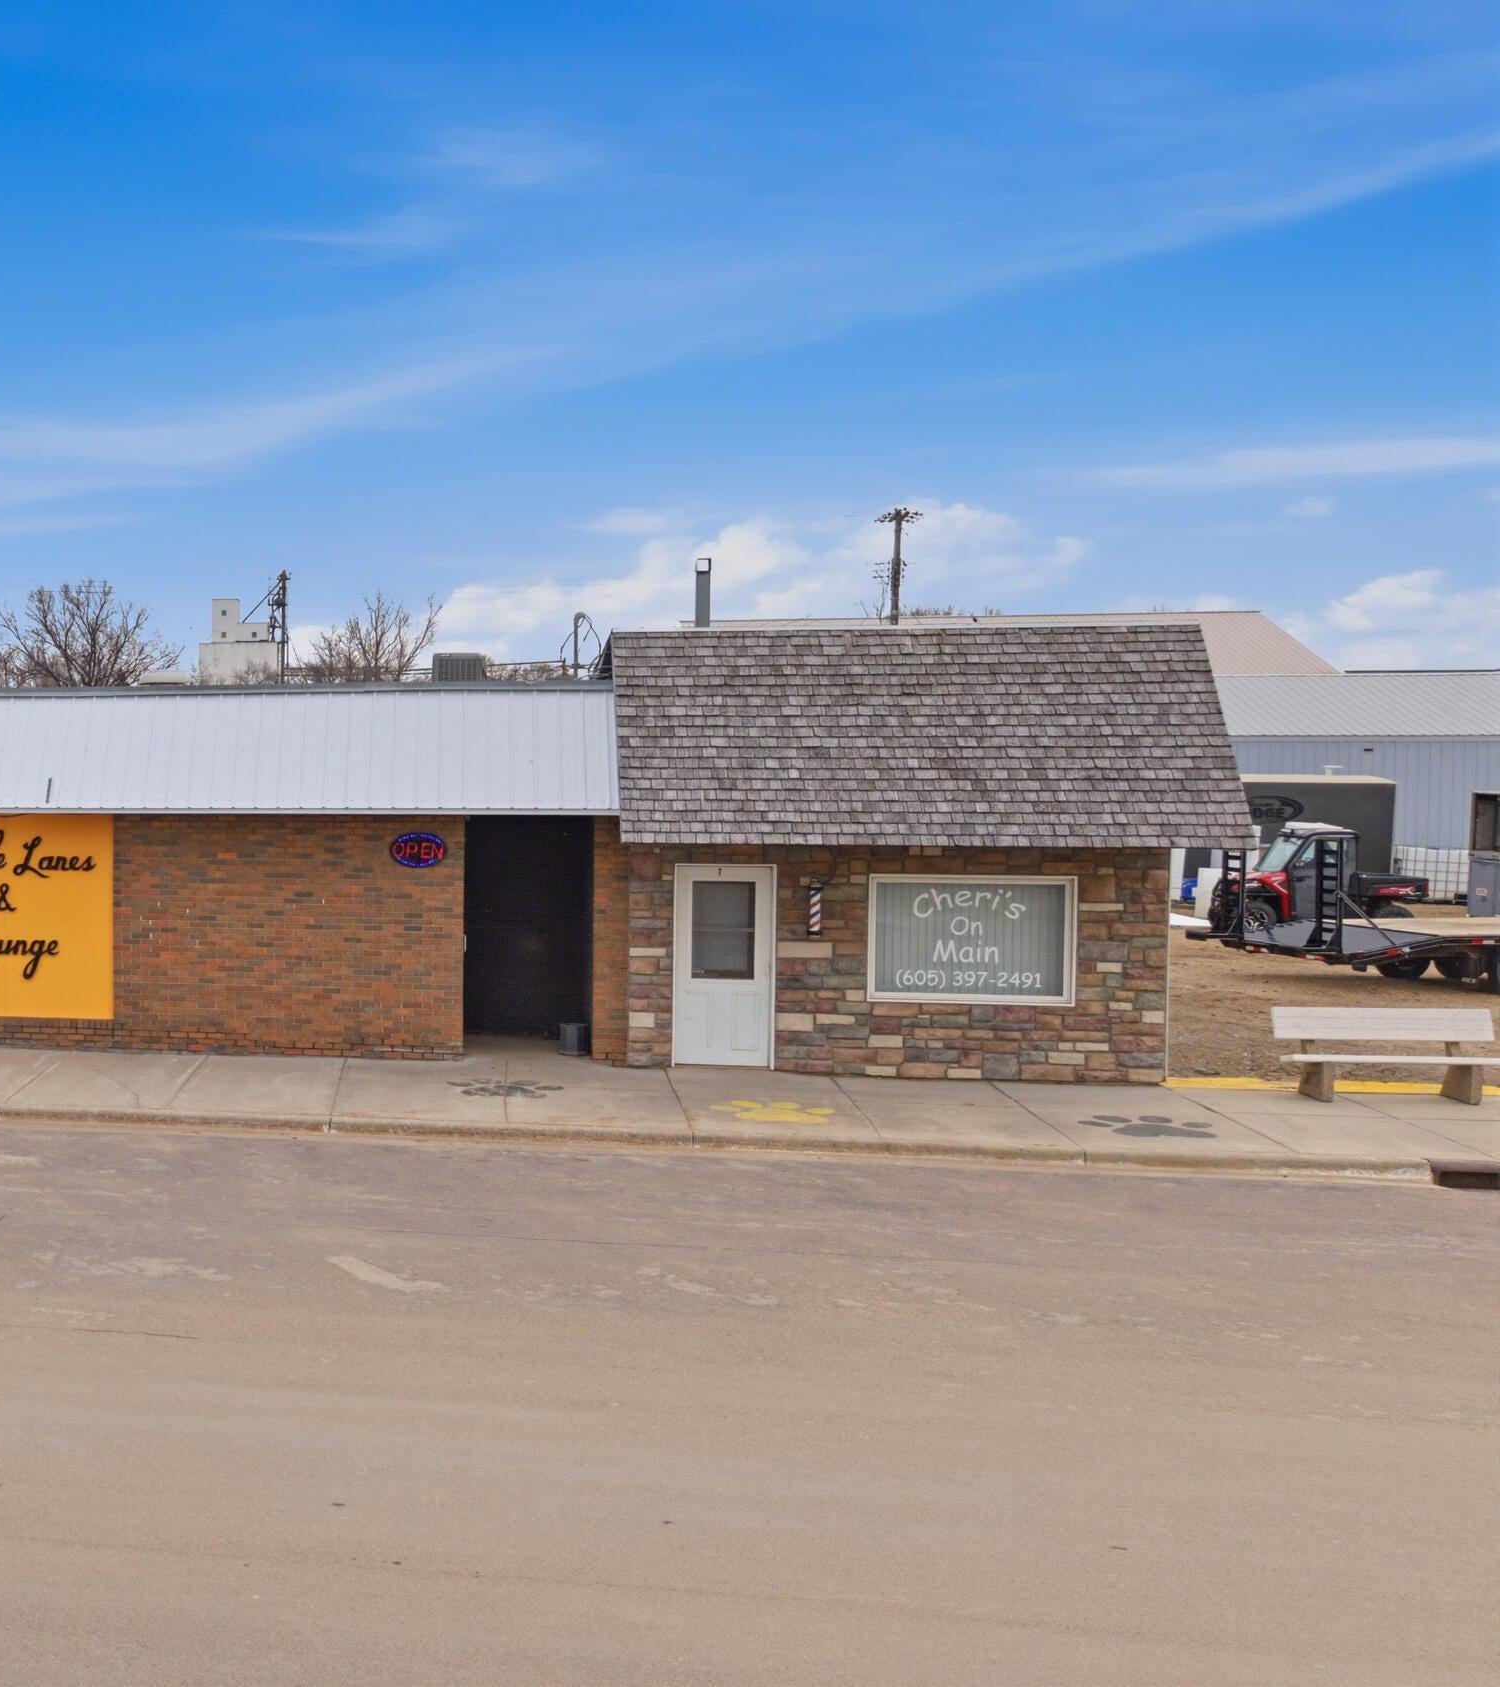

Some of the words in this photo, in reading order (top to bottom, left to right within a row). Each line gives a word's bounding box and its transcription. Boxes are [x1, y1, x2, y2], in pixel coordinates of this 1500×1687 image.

[13, 836, 96, 878] Lanes
[392, 842, 444, 859] OPEN
[913, 888, 1026, 920] Cheri's
[950, 916, 983, 936] On
[932, 939, 999, 963] Main
[895, 969, 946, 989] (605)
[952, 971, 1043, 988] 397-2491
